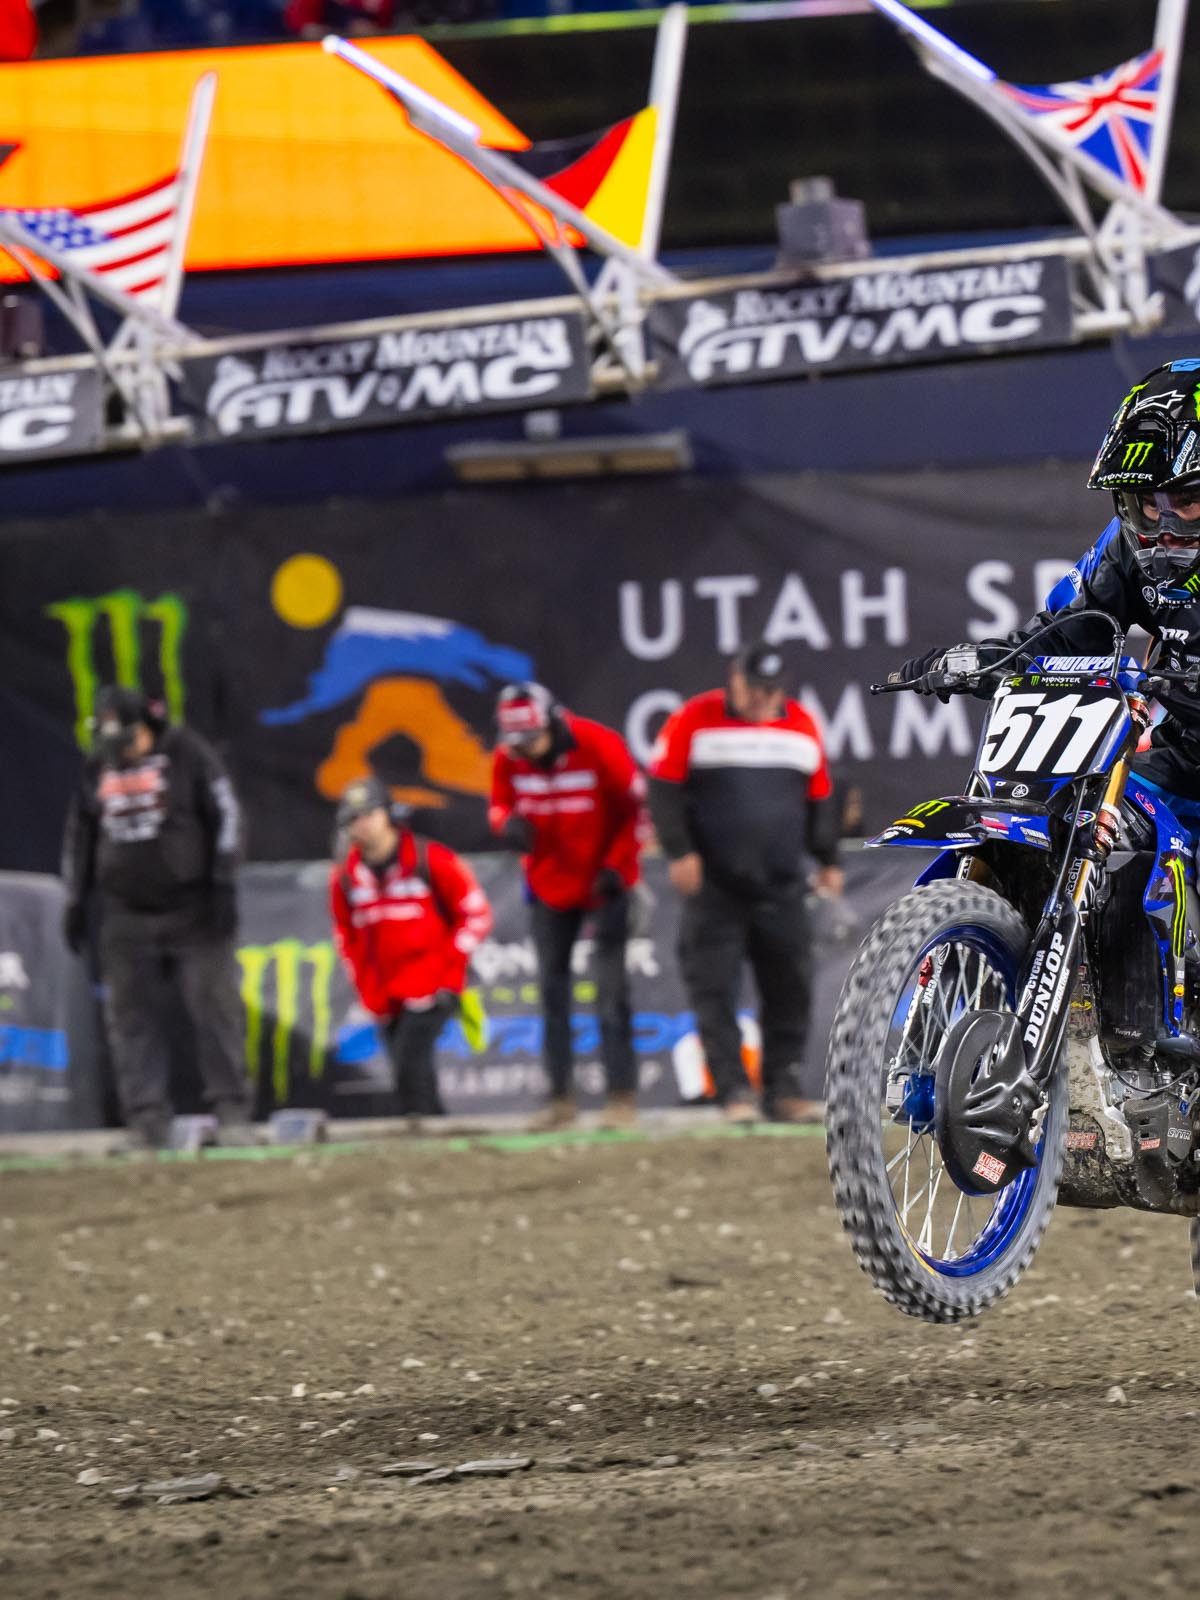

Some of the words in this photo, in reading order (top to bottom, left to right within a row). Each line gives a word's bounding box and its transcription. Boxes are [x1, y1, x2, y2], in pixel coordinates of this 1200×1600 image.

[1097, 472, 1153, 482] MONSTER
[618, 566, 908, 662] UTAH
[1041, 676, 1081, 684] MONSTER
[978, 692, 1121, 774] 511
[1024, 931, 1065, 1048] DUNLOP
